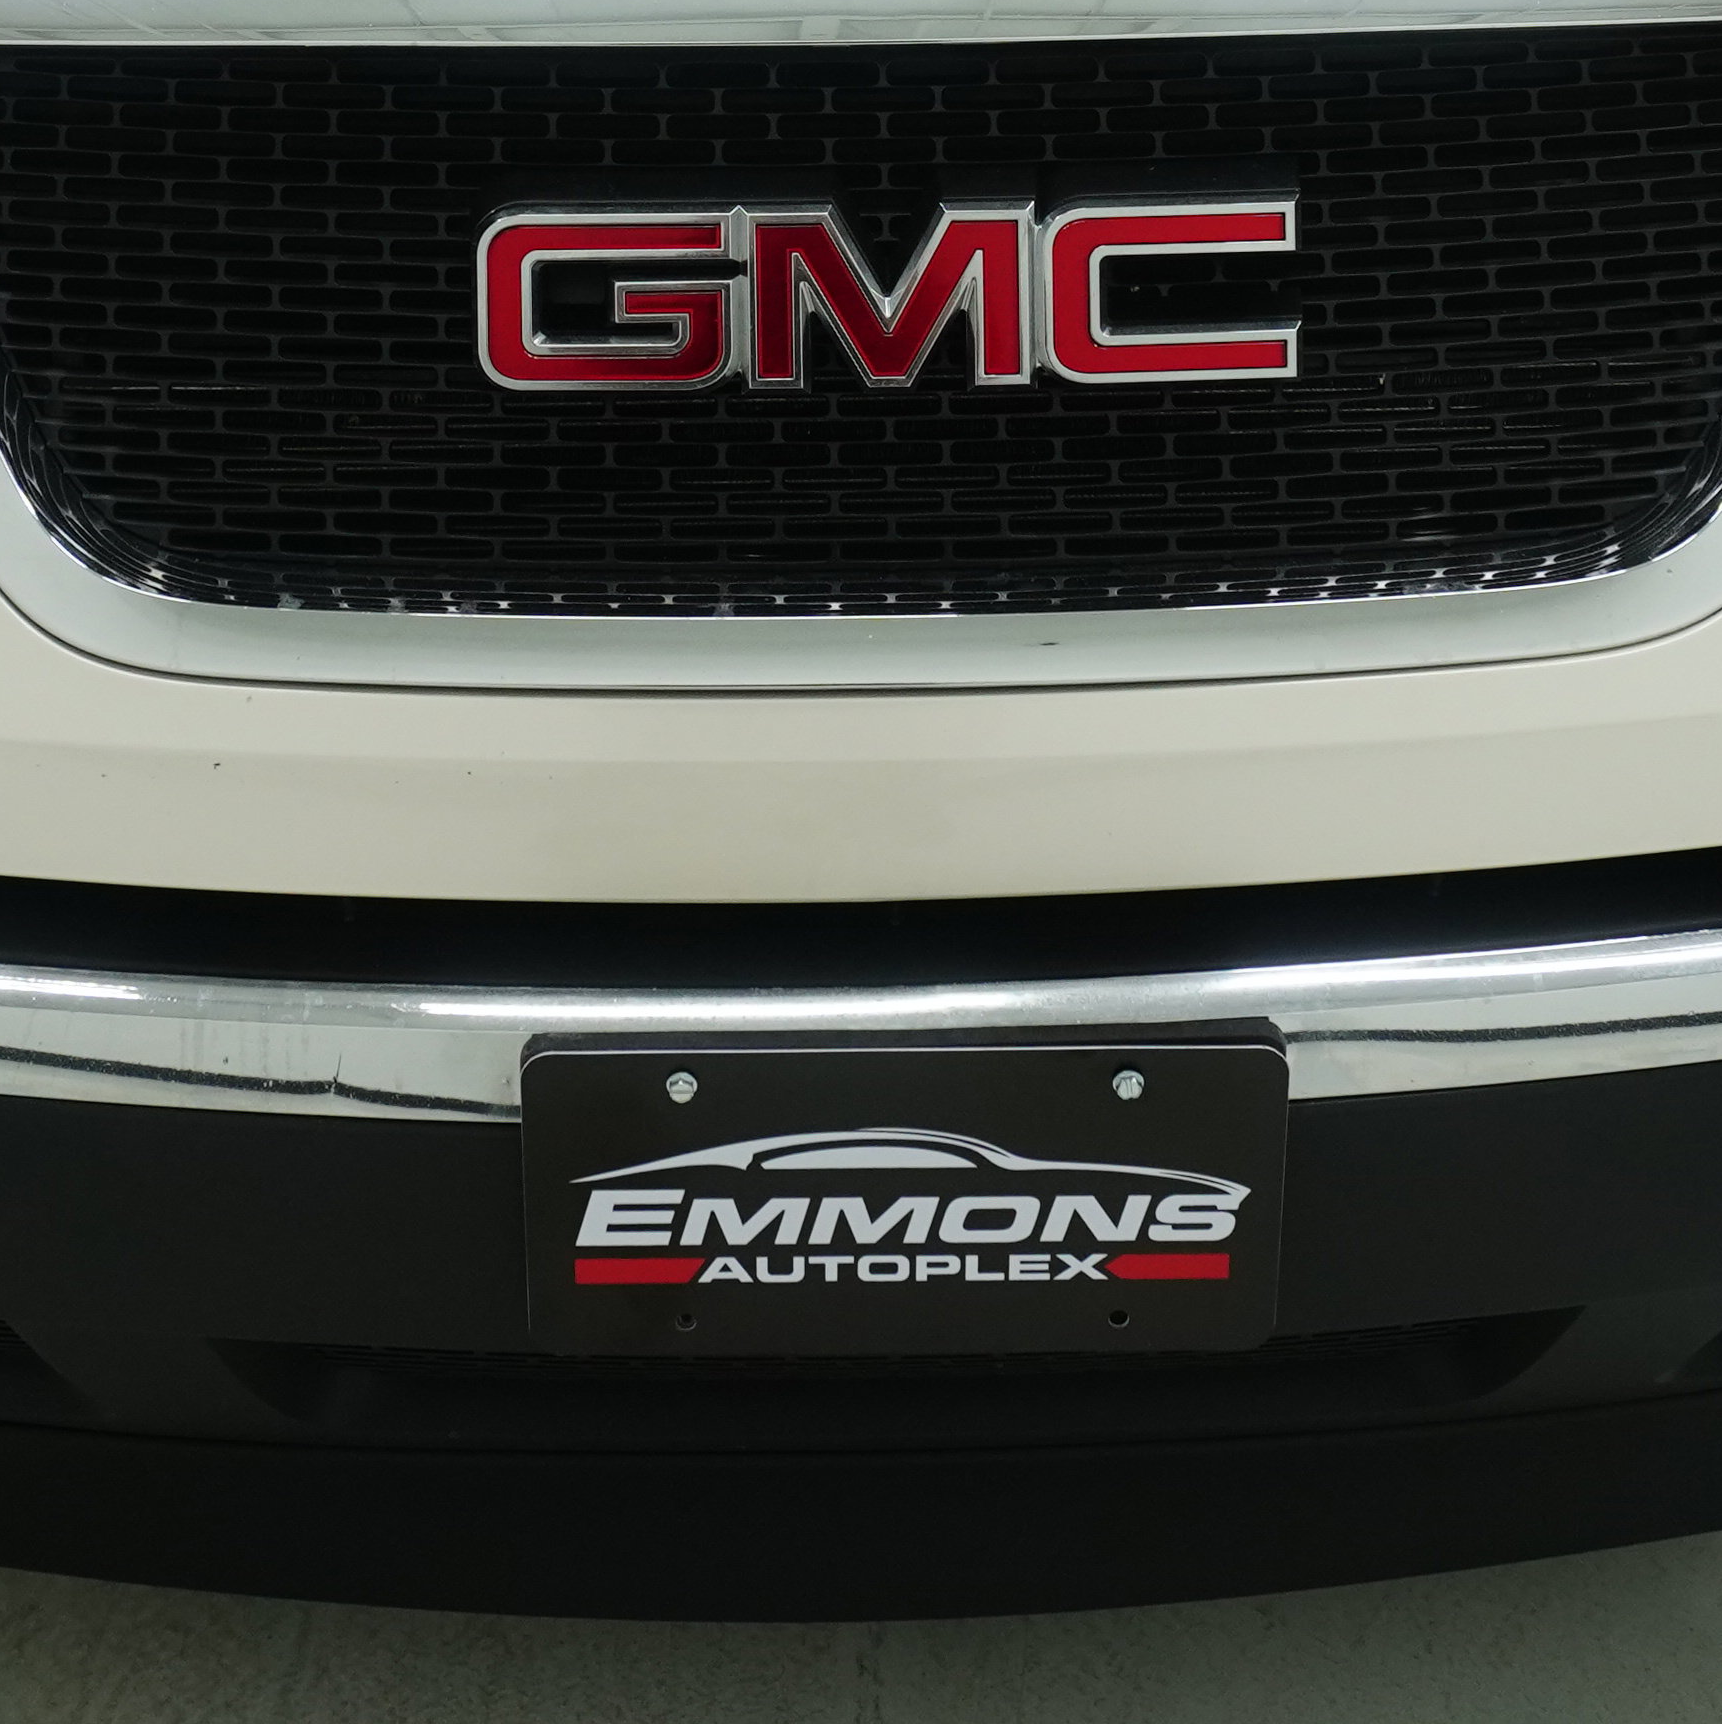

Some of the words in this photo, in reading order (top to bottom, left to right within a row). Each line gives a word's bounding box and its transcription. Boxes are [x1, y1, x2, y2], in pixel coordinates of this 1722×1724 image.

[477, 202, 1299, 391] GMC
[576, 1190, 1242, 1246] EMMONS
[698, 1254, 1108, 1283] AUTOPLEX
